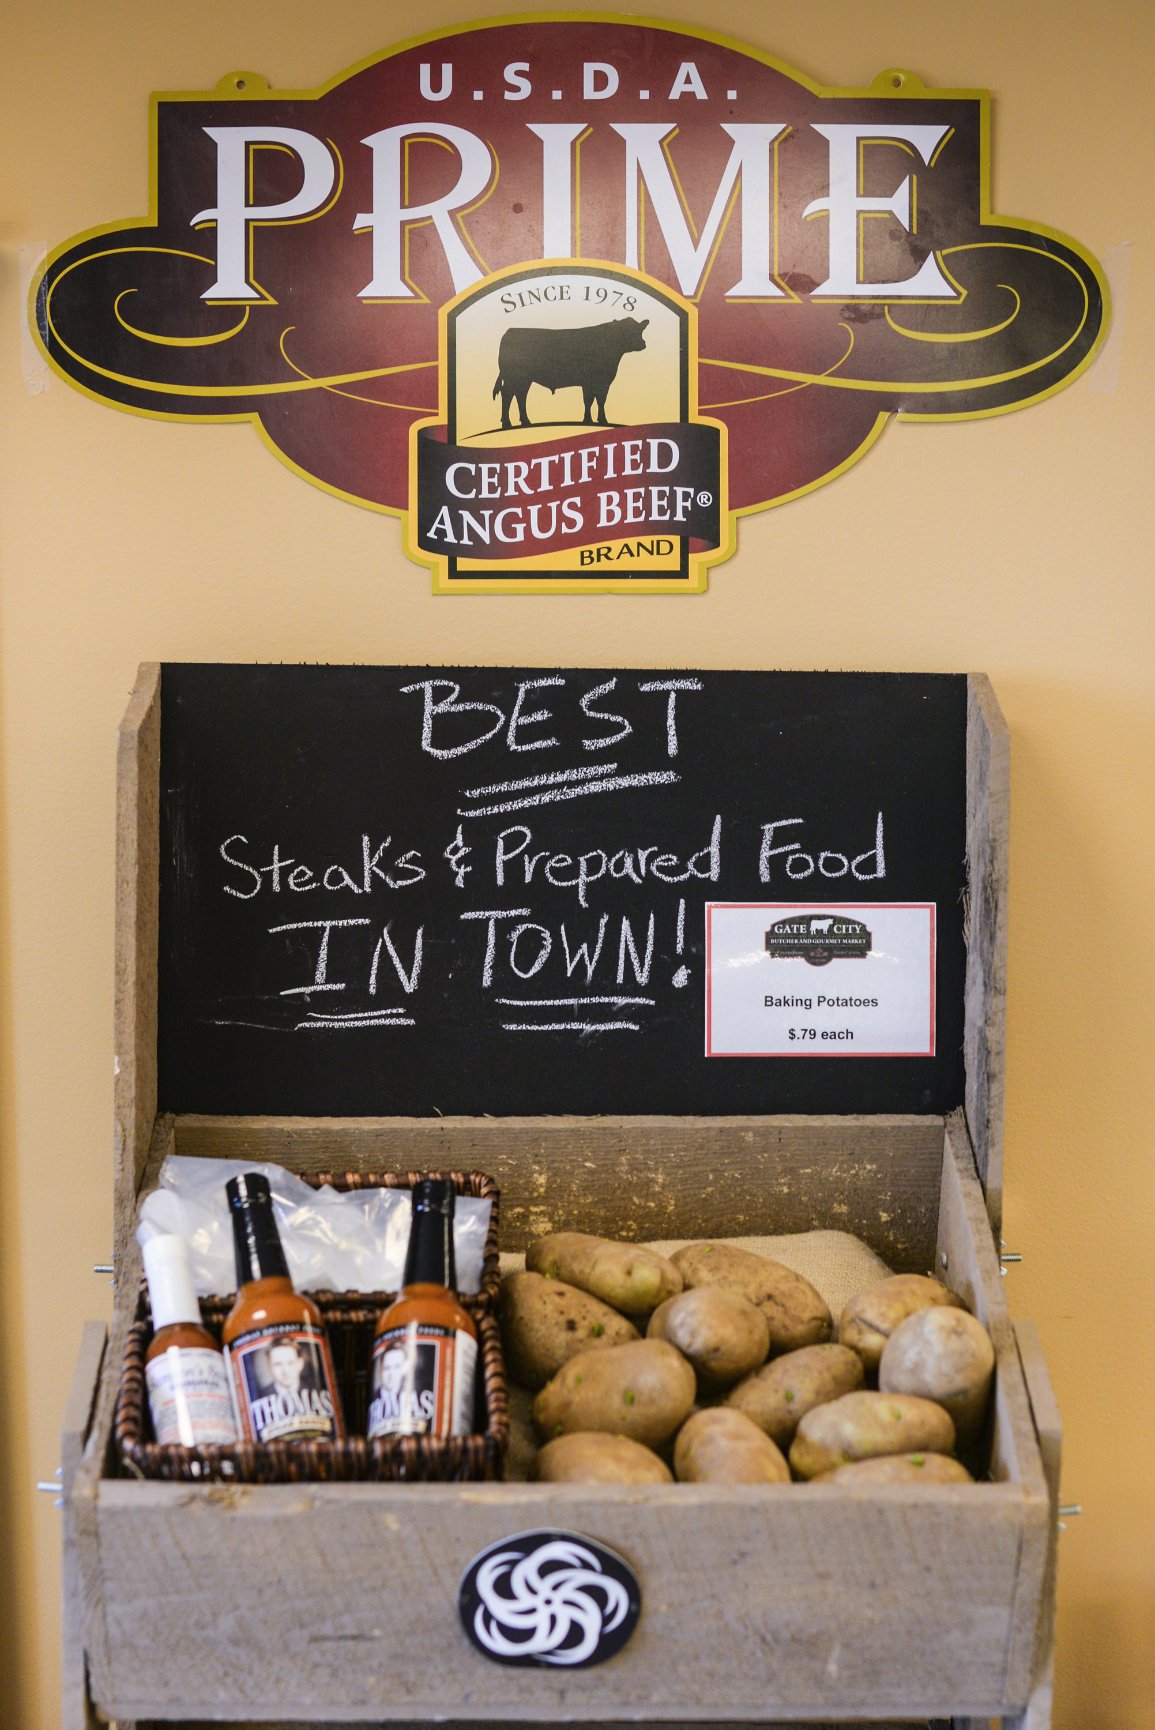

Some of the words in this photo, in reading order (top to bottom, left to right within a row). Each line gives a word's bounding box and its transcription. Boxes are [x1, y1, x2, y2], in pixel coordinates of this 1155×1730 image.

[419, 61, 738, 102] U.S.D.A.
[190, 121, 960, 300] PRIME
[583, 285, 638, 313] 1978
[445, 437, 680, 499] CERTIFIED
[426, 496, 584, 546] ANGUS
[579, 538, 674, 566] BRAND
[400, 675, 704, 760] BEST
[443, 824, 473, 888] &
[496, 814, 721, 909] Prepared
[759, 811, 886, 884] Food
[267, 917, 425, 996] IN
[459, 898, 691, 989] TOWN!
[774, 924, 807, 934] GATE
[833, 924, 862, 934] CITY
[764, 995, 812, 1010] Baking
[817, 995, 879, 1008] Potatoes
[788, 1028, 817, 1041] $.79
[821, 1028, 854, 1040] each
